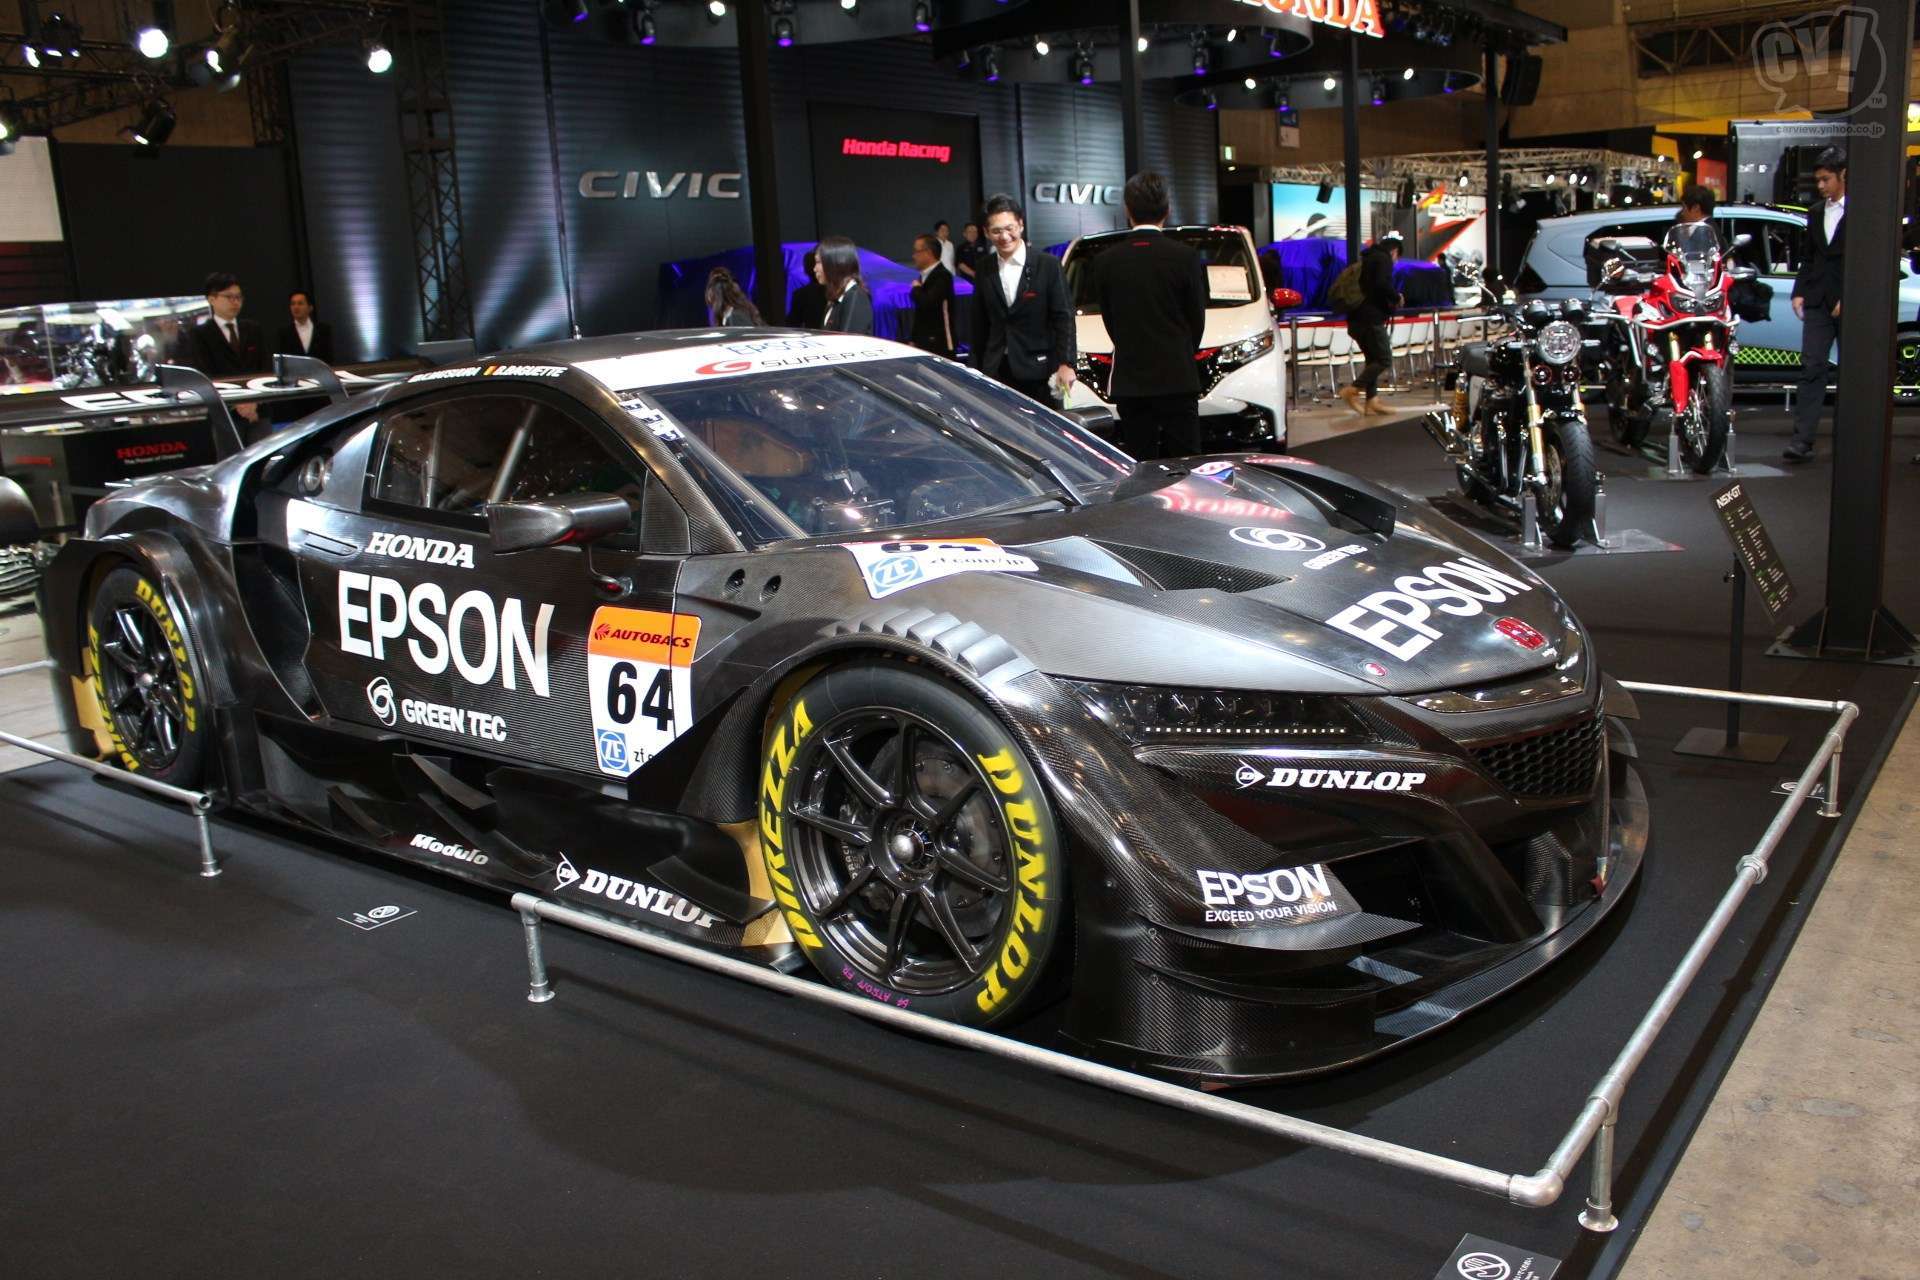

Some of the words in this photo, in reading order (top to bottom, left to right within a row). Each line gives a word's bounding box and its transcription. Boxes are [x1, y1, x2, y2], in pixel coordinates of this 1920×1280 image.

[842, 138, 897, 157] Honda
[898, 140, 951, 163] Racing
[578, 171, 742, 198] CIVIC
[1035, 182, 1124, 205] CIVIC
[761, 352, 856, 368] SUPER
[115, 441, 188, 459] HONDA
[365, 531, 475, 569] HONDA
[1324, 557, 1533, 662] EPSON
[338, 569, 555, 698] EPSON
[611, 628, 692, 649] AUTOBACS
[607, 661, 674, 732] 64
[401, 698, 466, 734] GREEN
[467, 710, 508, 742] TEC
[1266, 767, 1427, 791] DUNLOP
[409, 833, 489, 865] Modulo
[977, 745, 1048, 1013] DUNLOP
[1196, 863, 1332, 906] EPSON
[1205, 909, 1255, 923] EXCEED
[1256, 905, 1293, 921] YOUR
[1294, 900, 1338, 915] VISION
